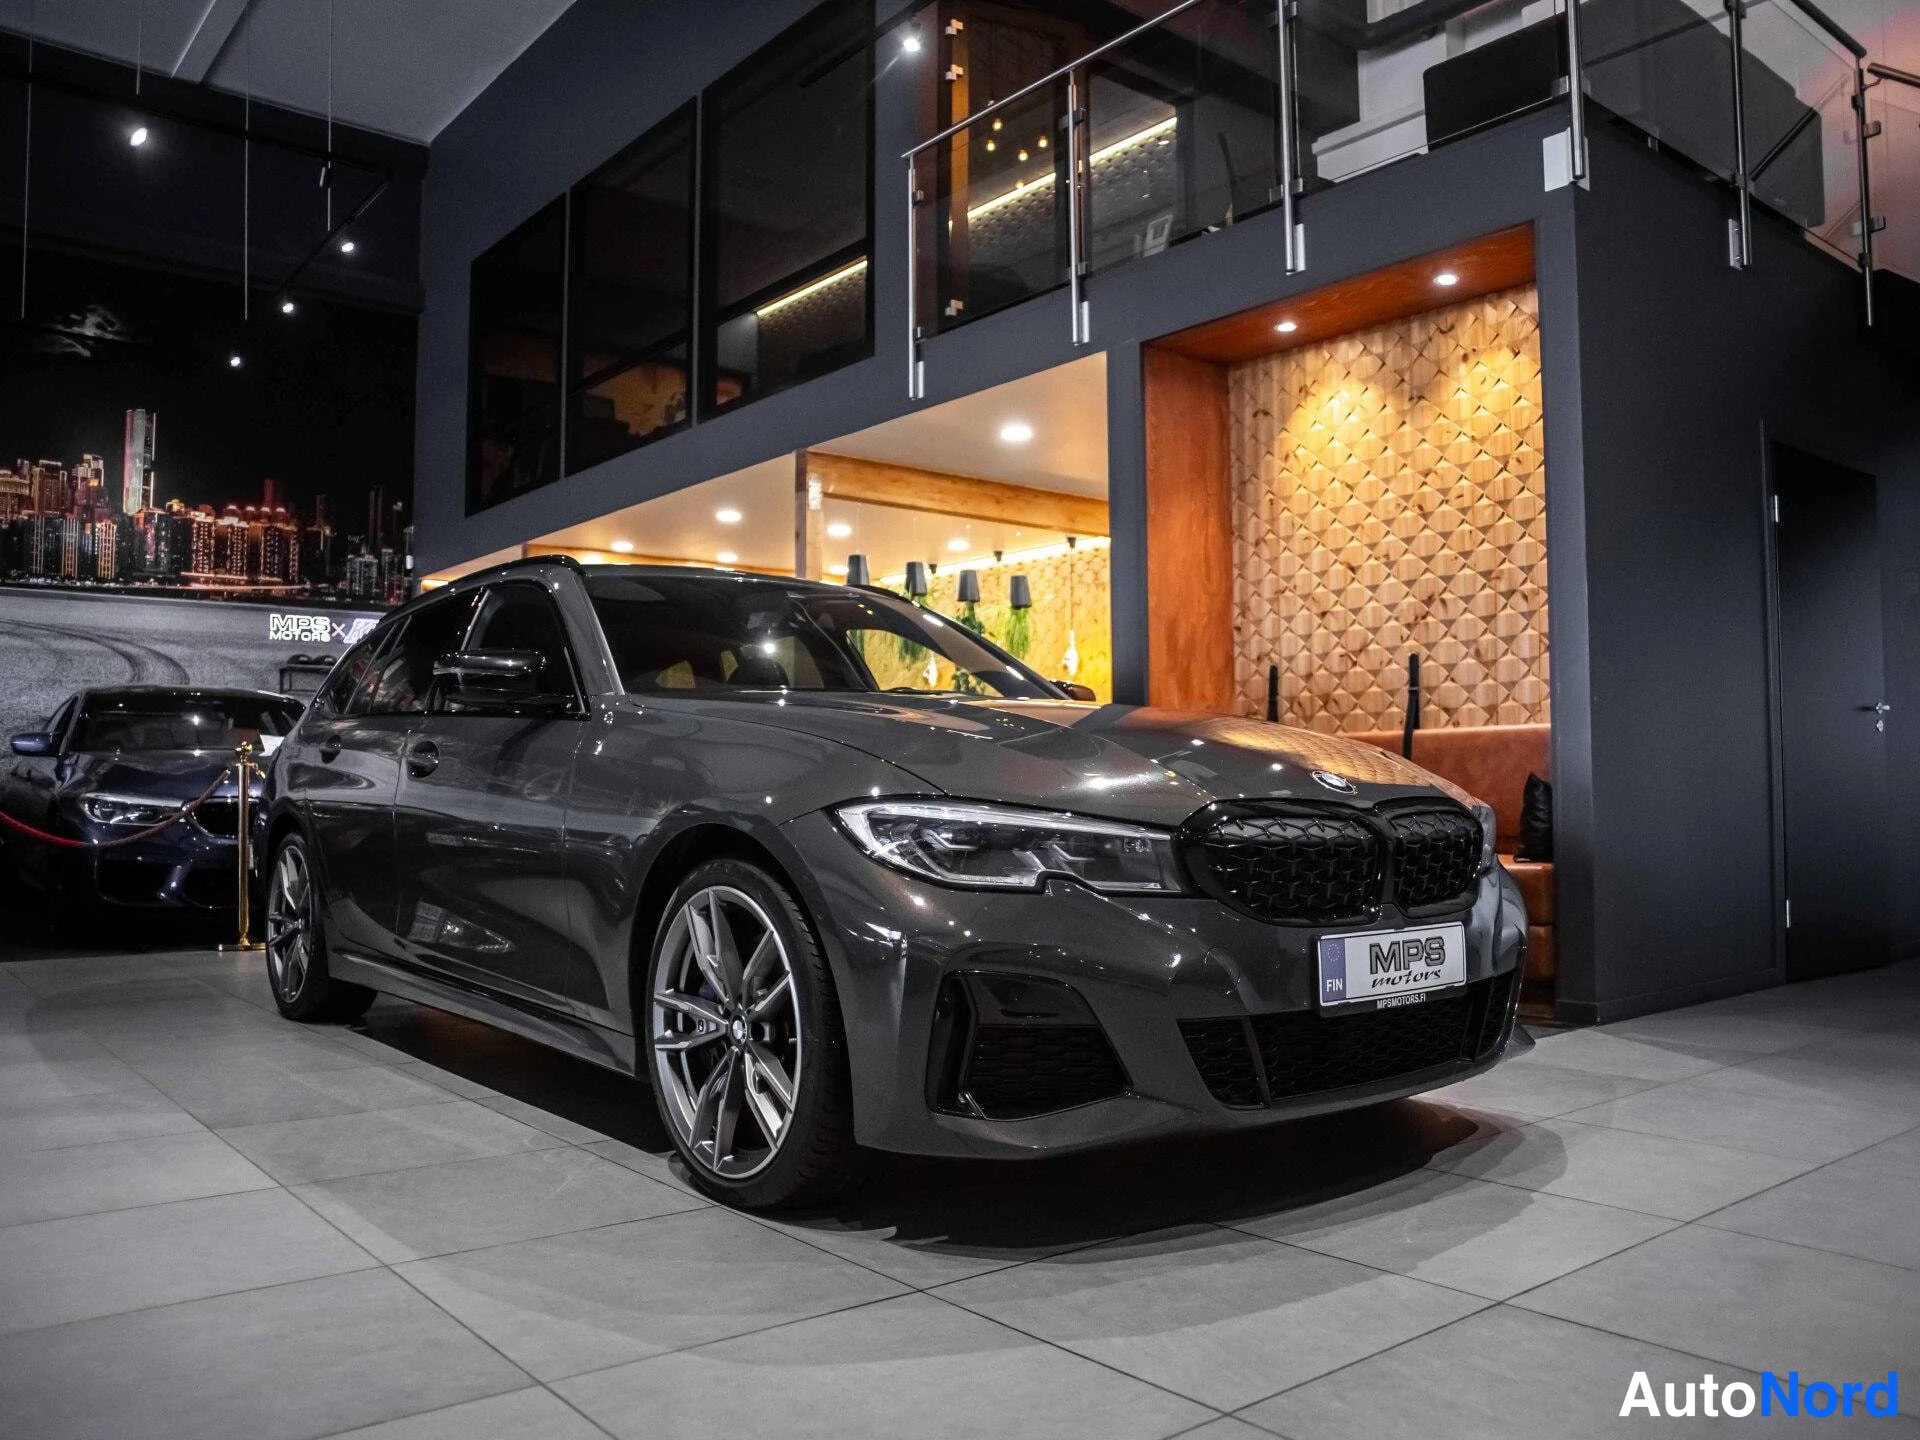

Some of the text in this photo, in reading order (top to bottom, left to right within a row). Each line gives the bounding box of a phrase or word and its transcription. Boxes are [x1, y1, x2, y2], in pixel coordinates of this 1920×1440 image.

[269, 613, 331, 633] MPS
[269, 631, 331, 642] MOTORS
[1369, 936, 1445, 975] MPS
[1326, 978, 1343, 992] FIN
[1371, 968, 1441, 988] motors
[1376, 993, 1426, 1009] MPSMOTORS.FI
